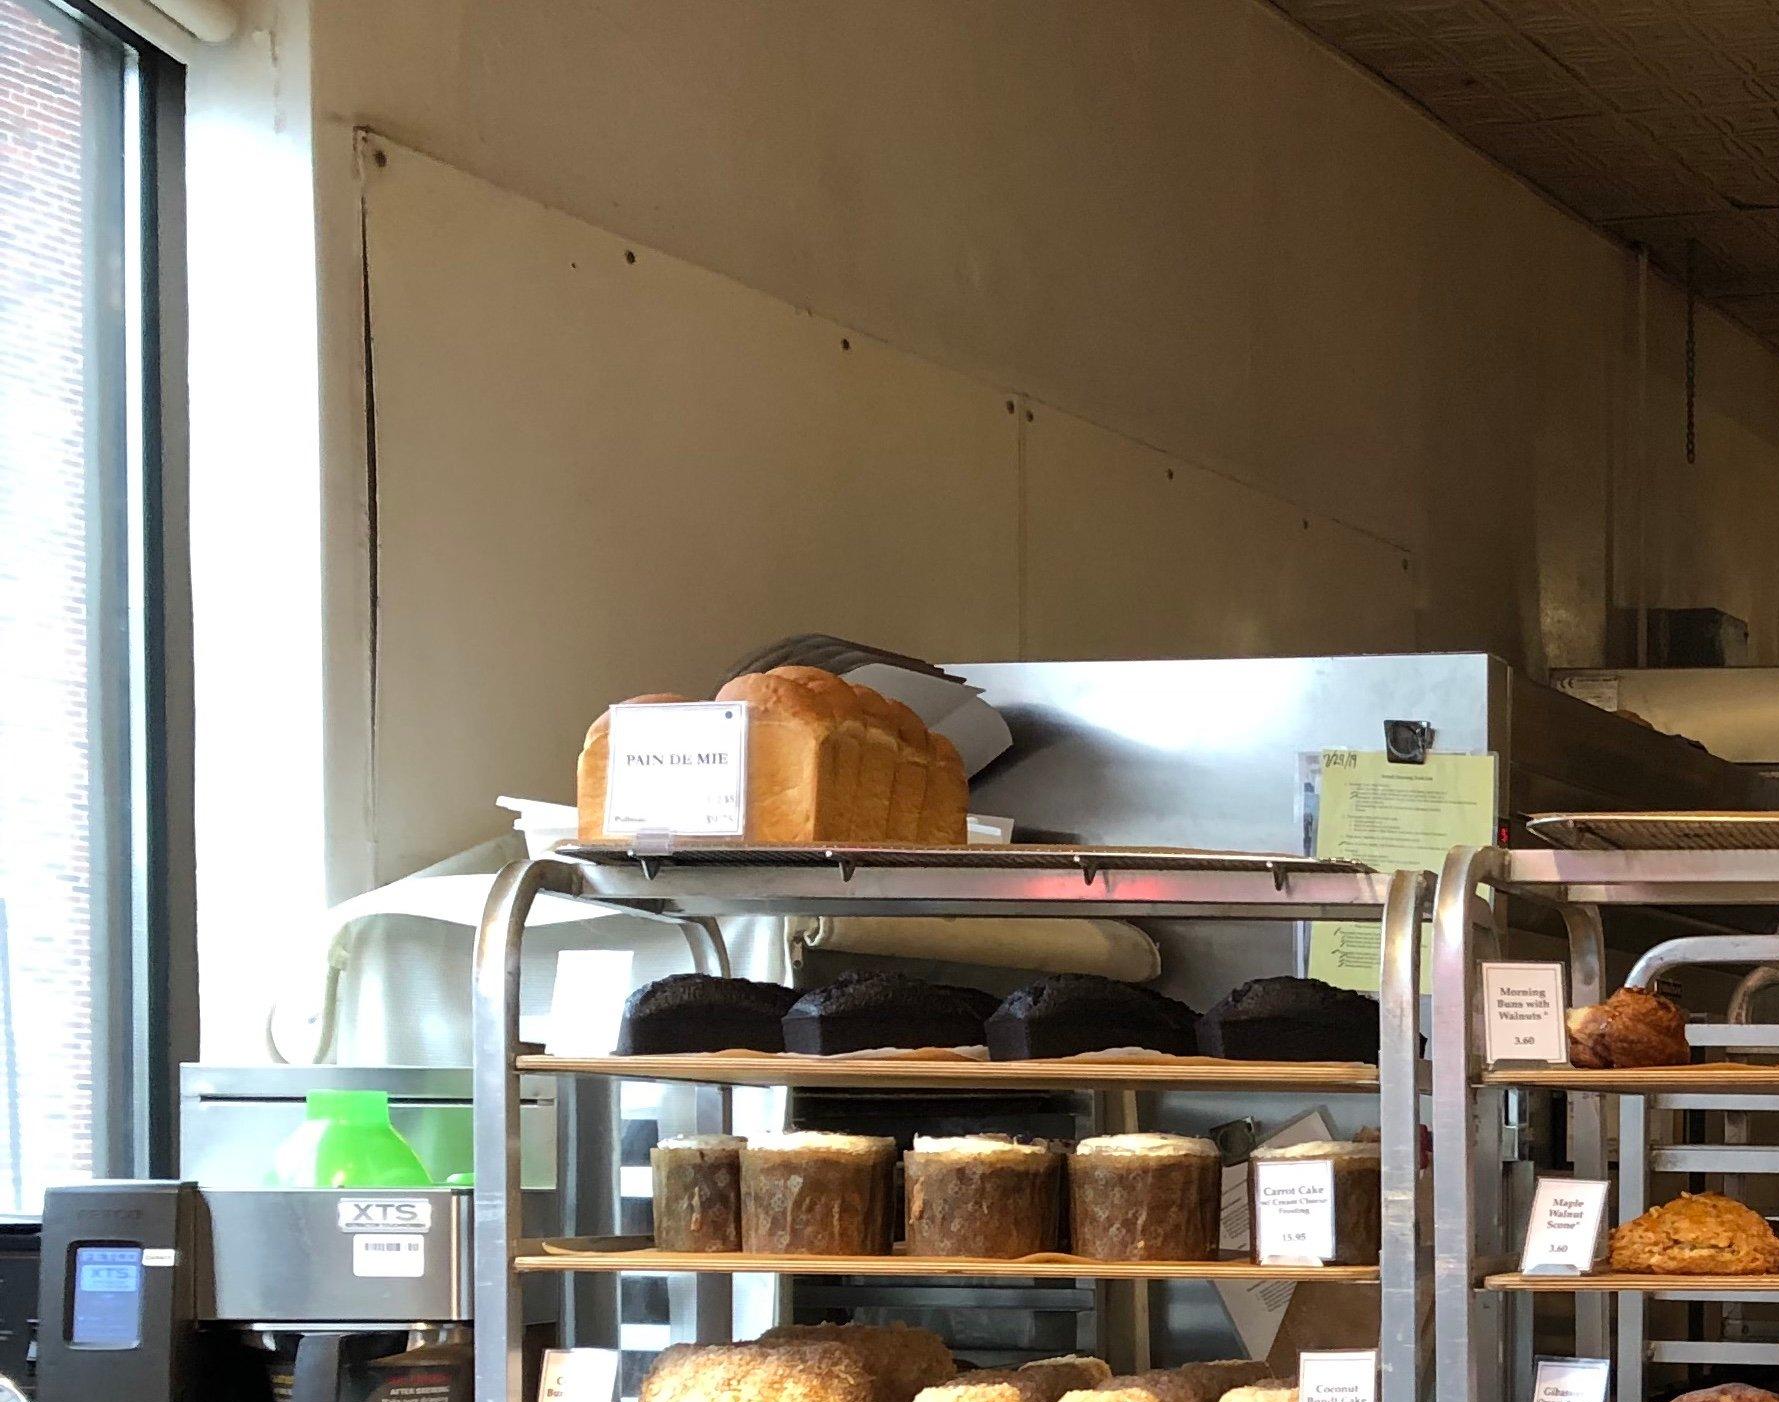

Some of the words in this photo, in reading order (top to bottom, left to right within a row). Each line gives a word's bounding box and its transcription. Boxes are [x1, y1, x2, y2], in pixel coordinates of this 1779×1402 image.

[626, 754, 663, 767] PAIN
[670, 754, 692, 766] DE
[697, 752, 728, 766] MIE
[1499, 988, 1546, 999] Morning
[1497, 1000, 1523, 1009] Buns
[1526, 999, 1550, 1009] with
[1514, 1036, 1535, 1045] 3.60
[1263, 1185, 1296, 1196] Carrot
[1298, 1185, 1324, 1195] Cake
[1552, 1199, 1584, 1209] Maple
[353, 1203, 418, 1221] XTS
[1549, 1209, 1584, 1220] Walnut
[1282, 1233, 1306, 1242] 15.95
[1315, 1384, 1358, 1394] Coconut
